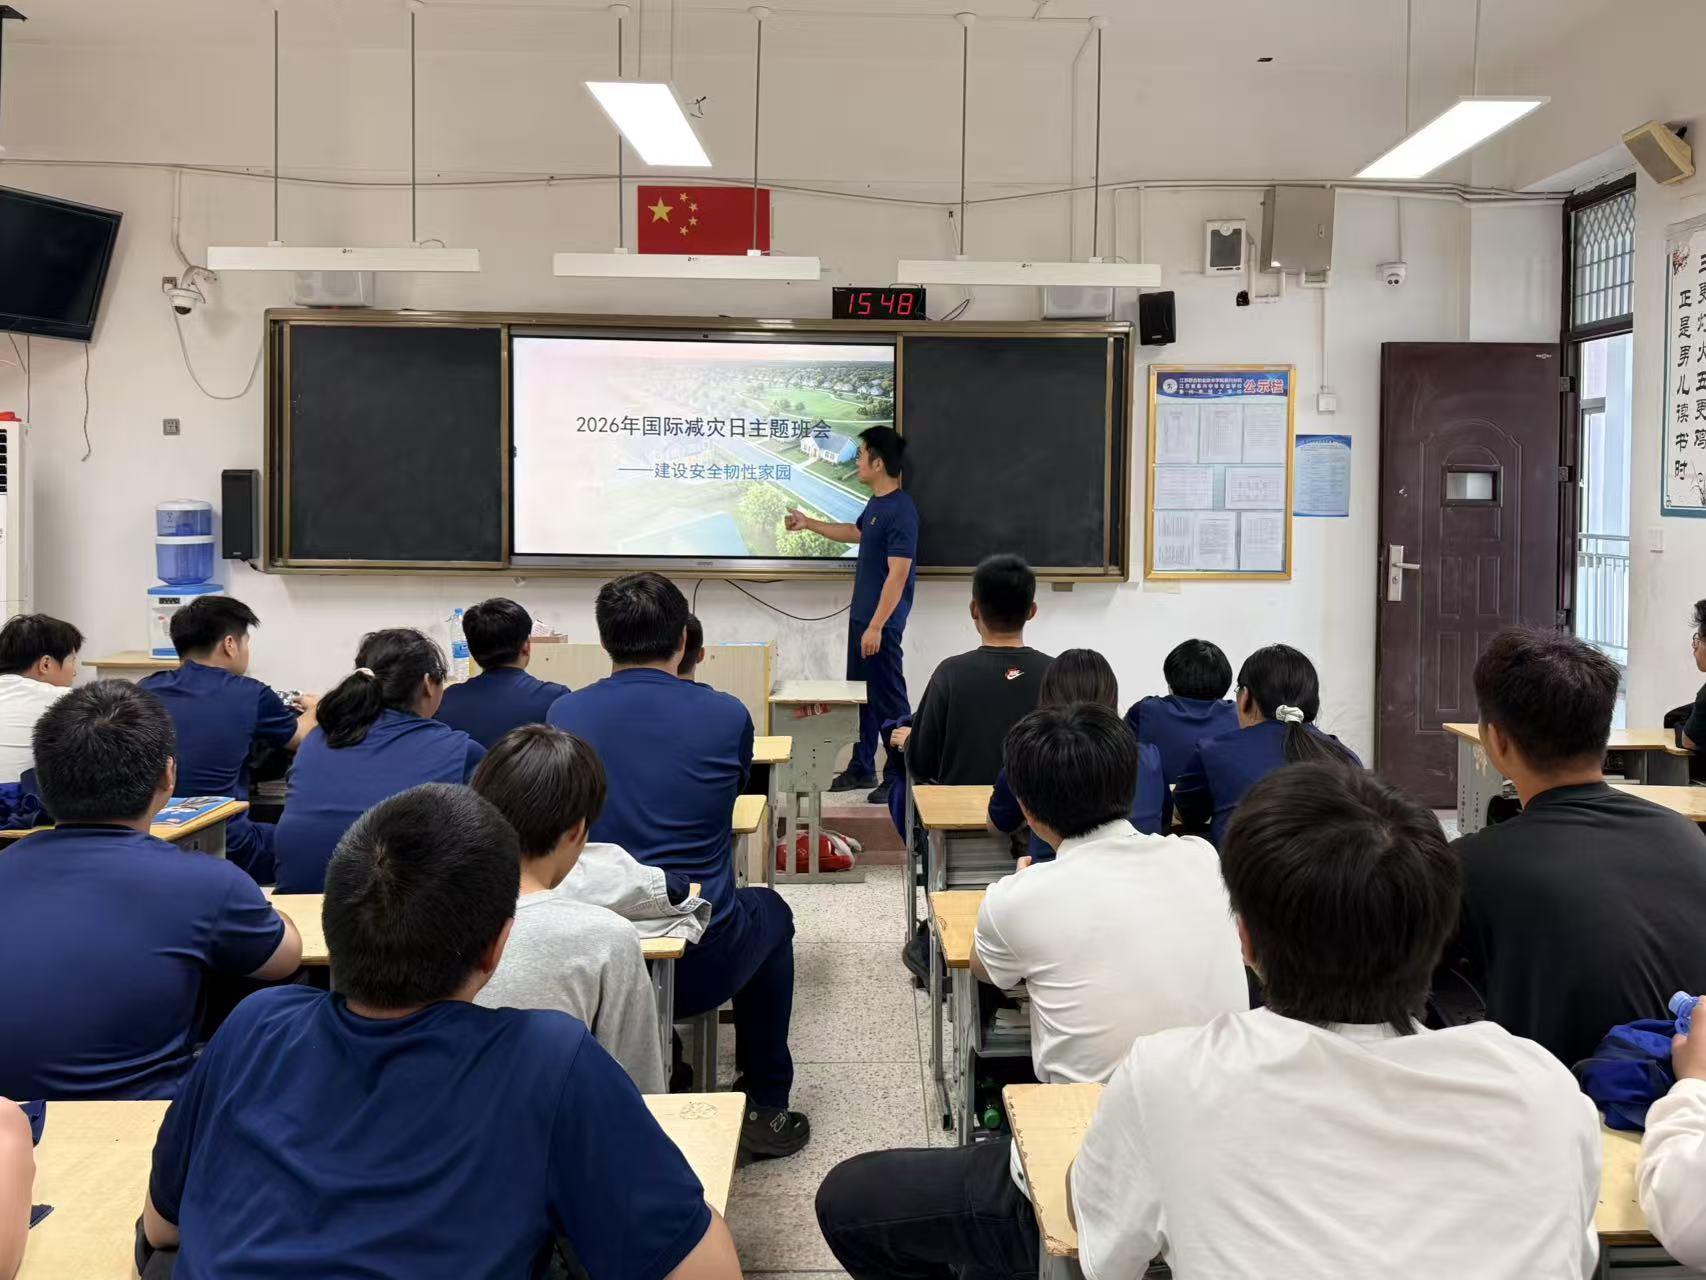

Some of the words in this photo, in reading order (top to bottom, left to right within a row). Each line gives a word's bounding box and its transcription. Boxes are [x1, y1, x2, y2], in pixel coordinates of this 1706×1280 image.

[1243, 378, 1284, 394] 公示栏
[1674, 289, 1692, 480] 正是男儿读书时
[576, 415, 832, 439] 2026年国际减灾日主题班会
